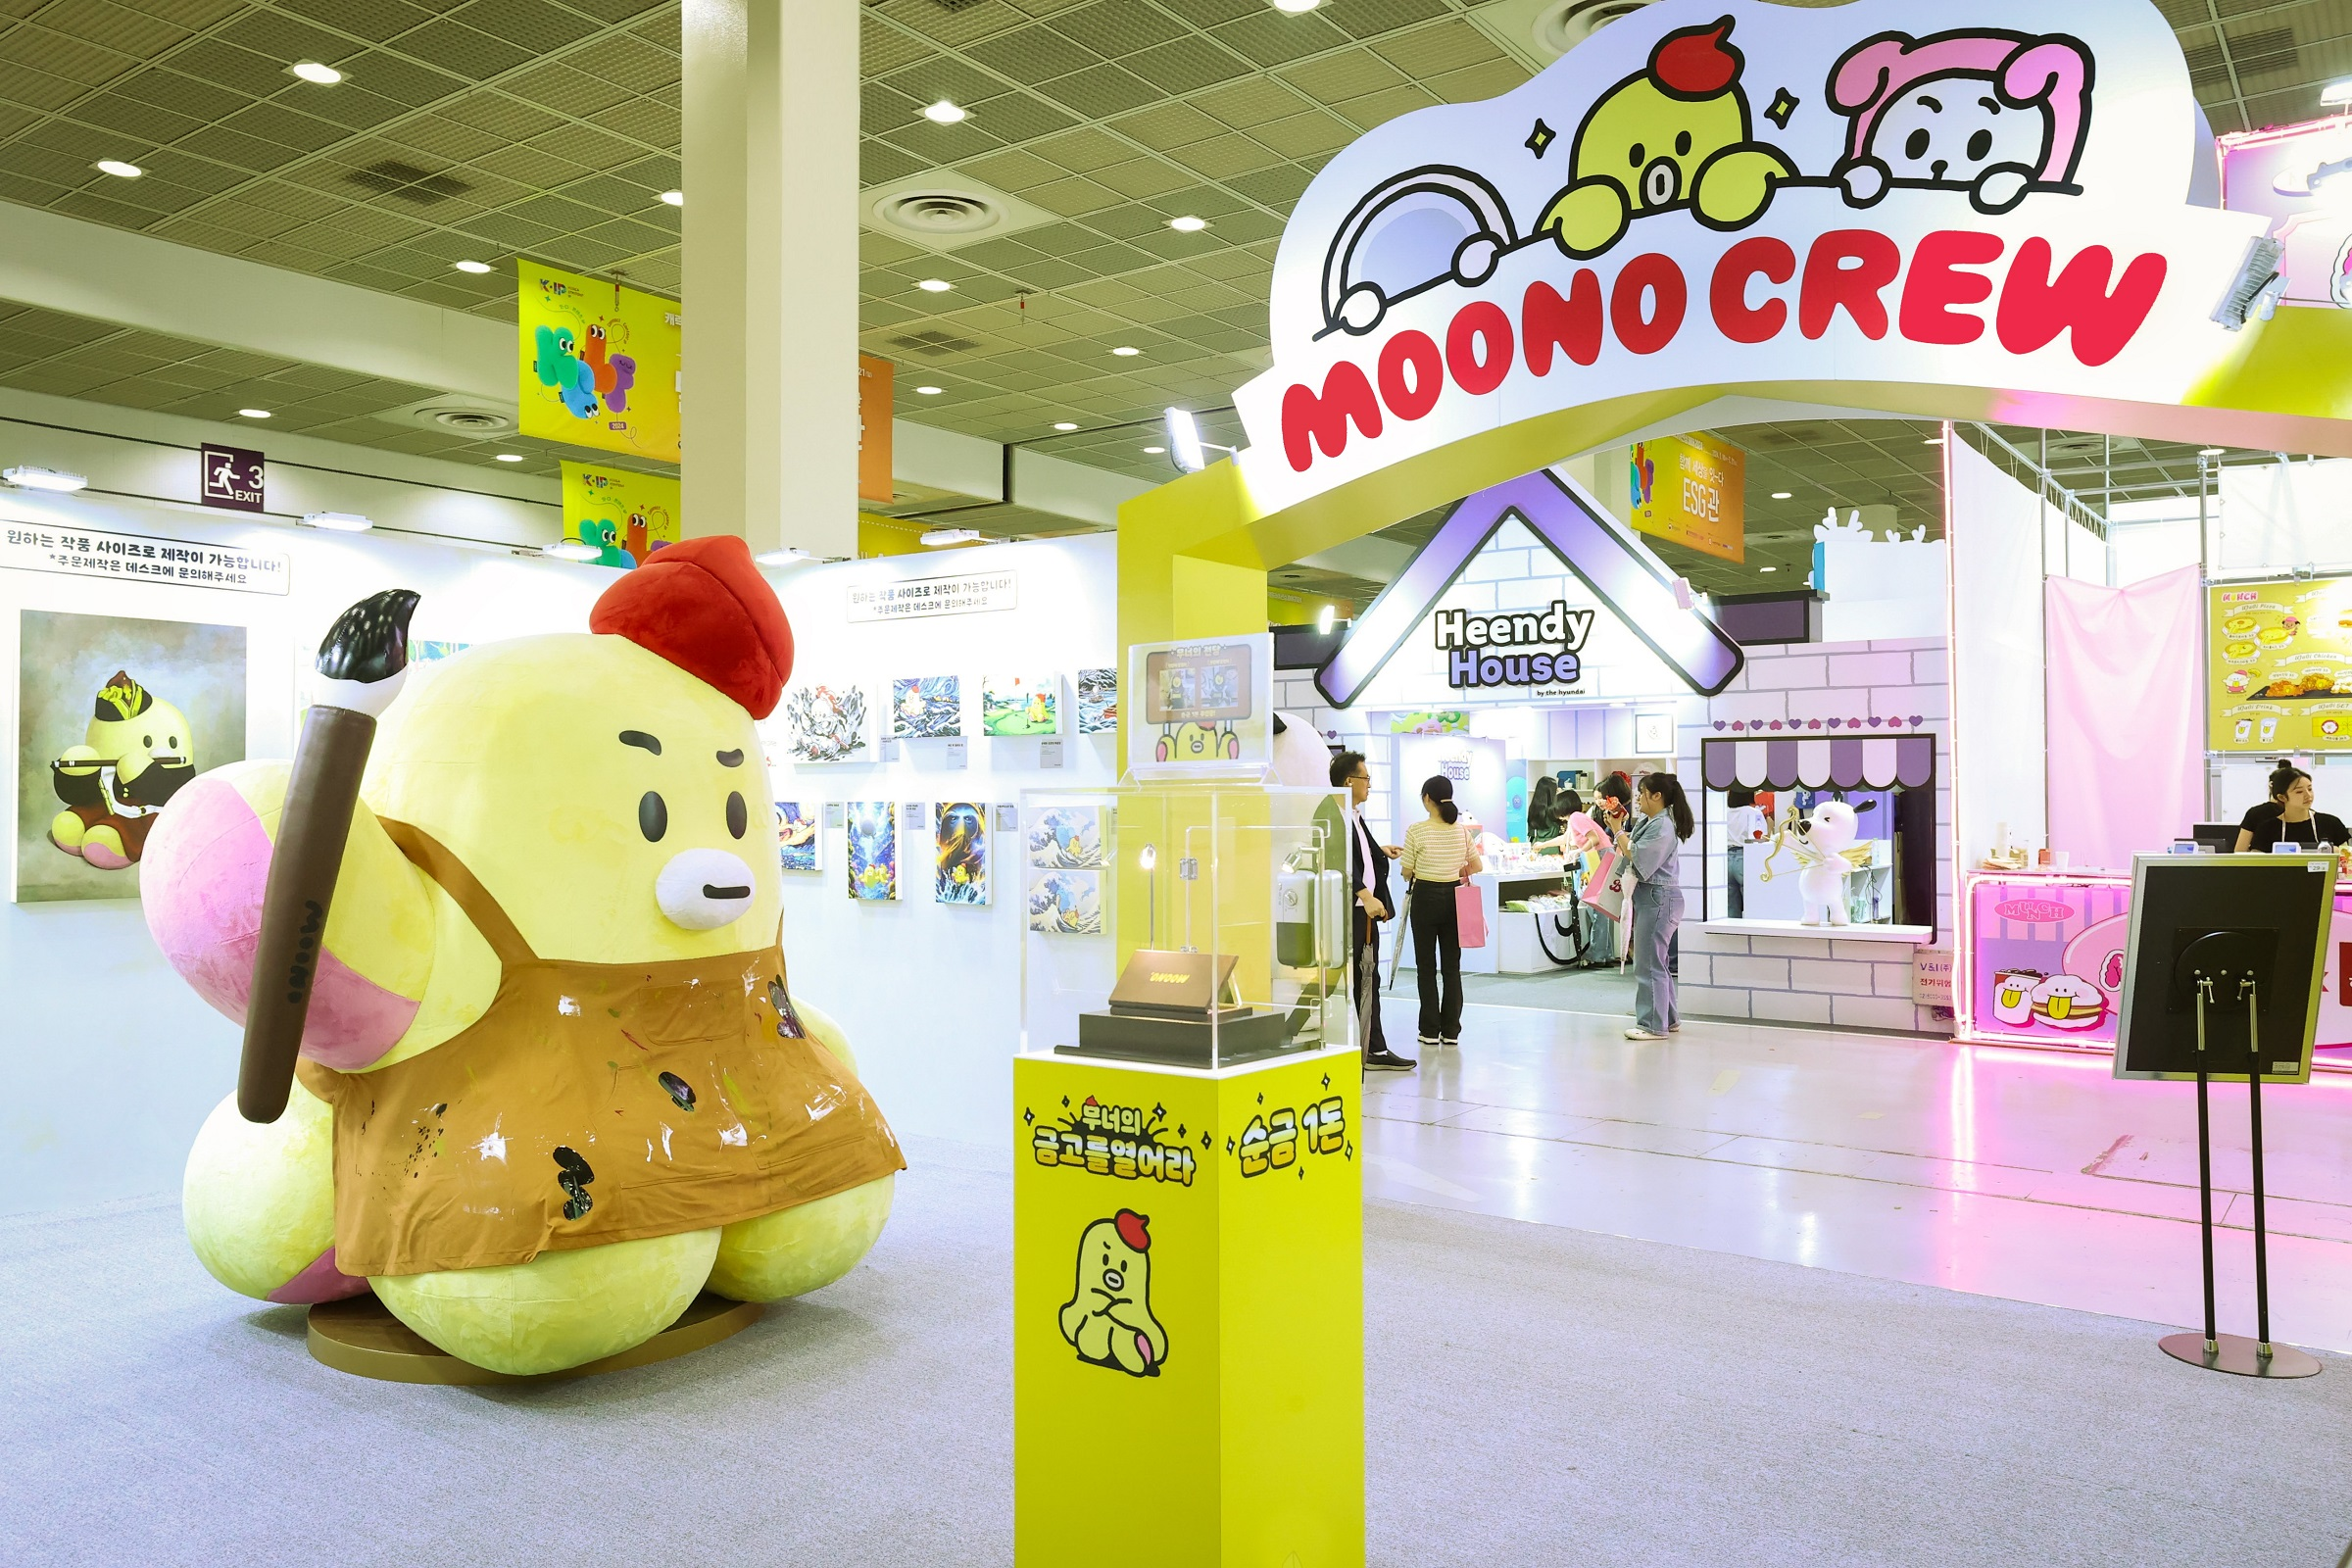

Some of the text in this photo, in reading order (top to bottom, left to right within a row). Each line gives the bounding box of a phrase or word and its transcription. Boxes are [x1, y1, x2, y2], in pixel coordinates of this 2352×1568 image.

[1280, 228, 2167, 472] MOONO CREW
[248, 466, 264, 489] 3
[234, 490, 262, 504] EXIT
[7, 529, 281, 573] 원하는 작품 사이즈로 제작이 가능합니다!
[125, 562, 174, 577] 데스크에
[178, 567, 248, 585] 문의해주세요
[879, 589, 895, 601] 작품
[898, 585, 931, 599] 사이즈로
[933, 583, 959, 596] 제작이
[913, 601, 942, 612] 데스크에
[1435, 599, 1595, 653] Heendy
[1448, 647, 1581, 688] House
[1558, 688, 1586, 697] hyundai
[1441, 762, 1470, 781] House
[2004, 901, 2064, 921] MUNCH
[1081, 1103, 1144, 1137] 무너의
[1239, 1095, 1346, 1179] 순금 1돈
